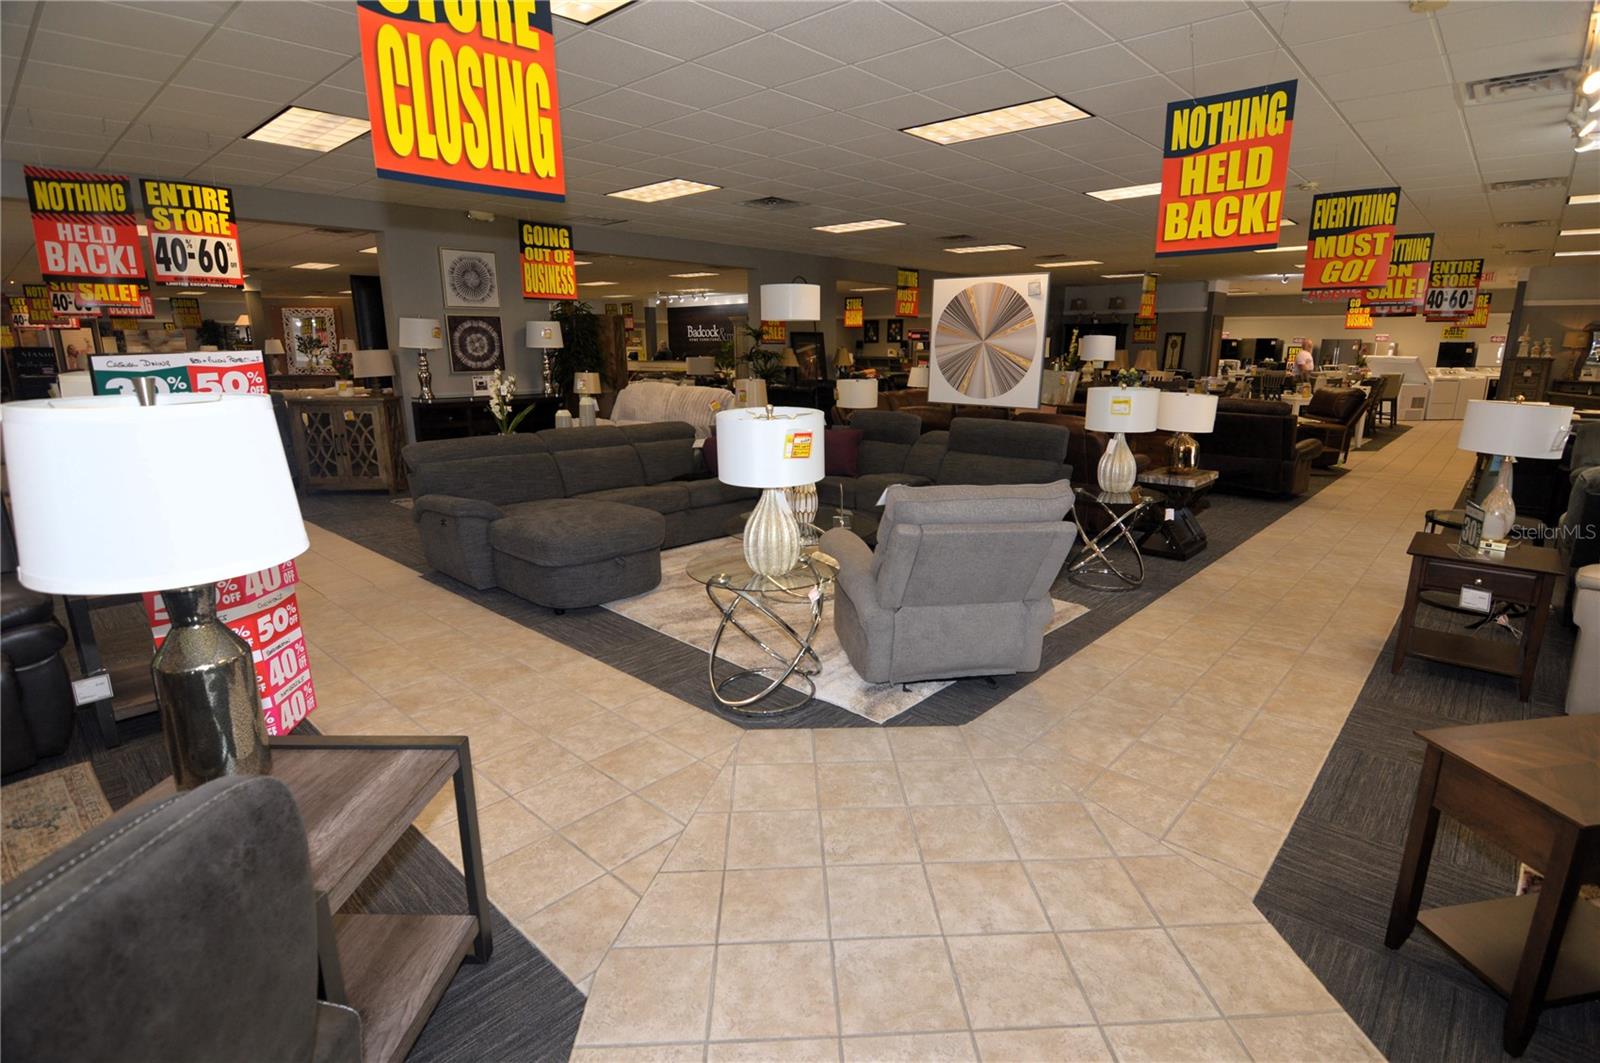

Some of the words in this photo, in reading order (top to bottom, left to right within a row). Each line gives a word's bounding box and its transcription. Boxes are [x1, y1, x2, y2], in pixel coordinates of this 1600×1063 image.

[377, 23, 556, 178] CLOSING
[1171, 90, 1288, 151] NOTHING
[1180, 146, 1273, 197] HELD
[33, 180, 127, 212] NOTHING
[145, 182, 231, 212] ENTIRE
[152, 207, 232, 236] STORE
[1163, 190, 1282, 241] BACK!
[1313, 192, 1396, 230] EVERYTHING
[57, 223, 116, 244] HELD
[522, 223, 570, 249] GOING
[1313, 232, 1390, 259] MUST
[44, 241, 138, 276] BACK!
[524, 248, 552, 263] OUT
[554, 250, 571, 264] OF
[1391, 237, 1432, 262] YTHING
[524, 264, 575, 296] BUSINESS
[1321, 259, 1376, 284] GO!
[1432, 260, 1481, 274] ENTIRE
[78, 283, 138, 302] SALE!
[1366, 278, 1425, 300] SALE!
[1431, 273, 1477, 288] STORE
[687, 324, 719, 338] Badcock
[250, 385, 265, 394] OFF
[283, 569, 295, 584] OFF
[222, 593, 241, 605] OFF
[256, 602, 297, 643] 50%
[288, 614, 299, 626] OFF
[269, 640, 305, 687] 40%
